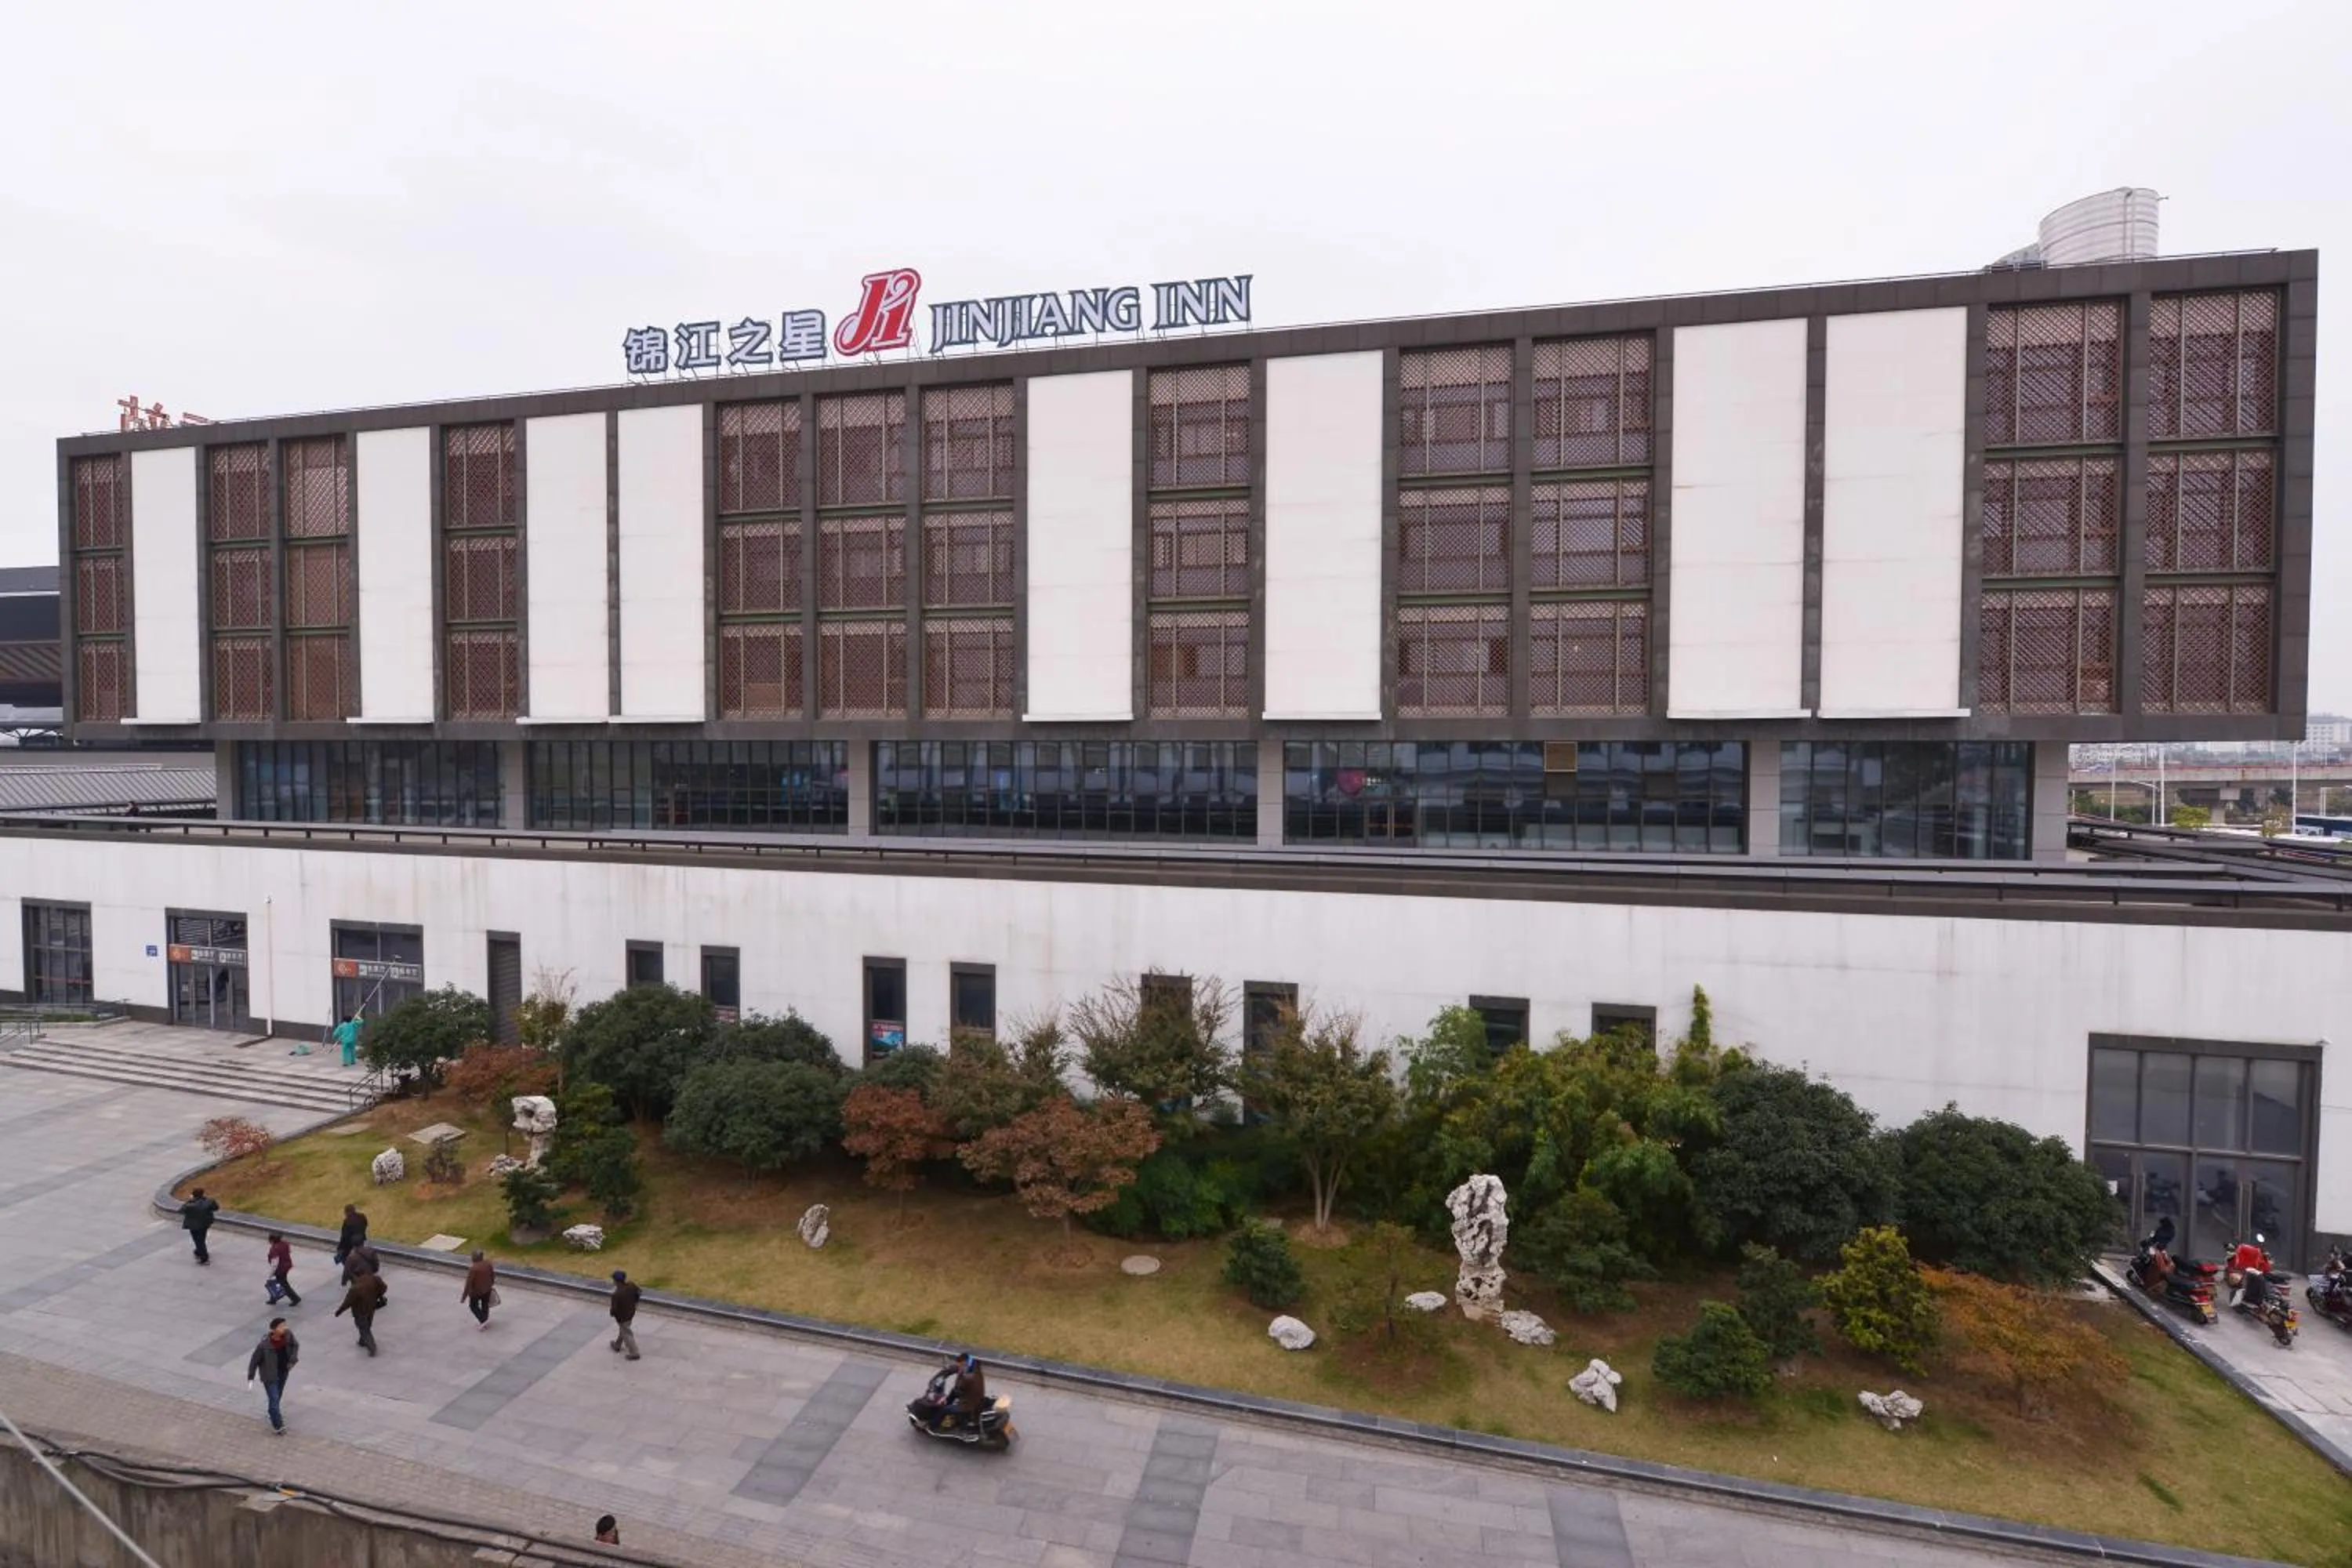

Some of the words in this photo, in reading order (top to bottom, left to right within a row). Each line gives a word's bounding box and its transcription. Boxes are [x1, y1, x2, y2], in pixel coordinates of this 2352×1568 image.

[623, 310, 826, 373] 锦江之星
[928, 286, 1142, 353] JINJIANG
[1150, 274, 1253, 330] INN
